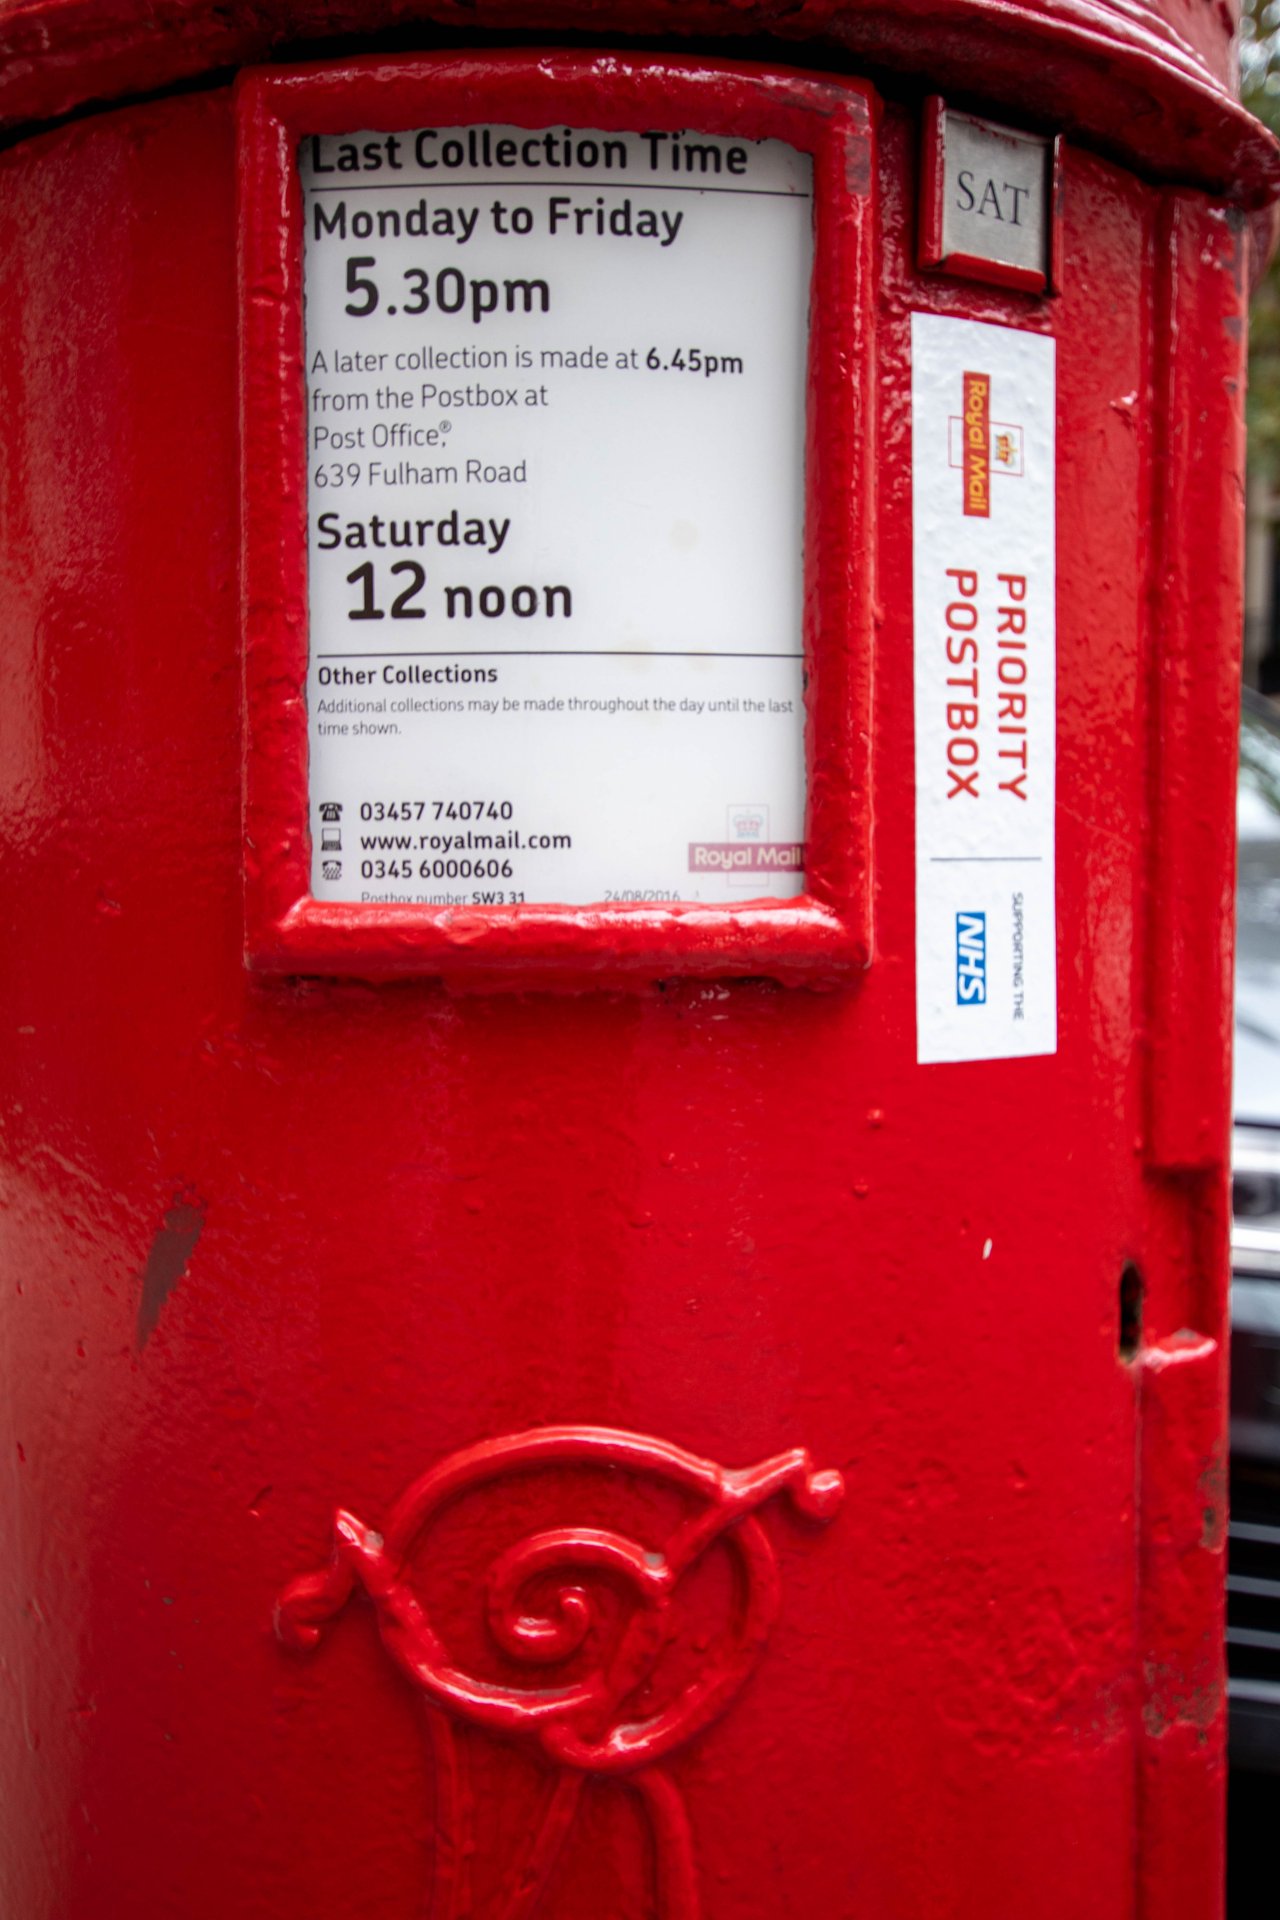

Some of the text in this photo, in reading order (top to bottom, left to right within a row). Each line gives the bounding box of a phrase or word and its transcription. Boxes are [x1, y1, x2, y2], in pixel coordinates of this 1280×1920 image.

[312, 129, 748, 174] Last Collection Time
[956, 170, 1030, 226] SAT
[313, 197, 684, 246] Monday to Friday
[344, 256, 550, 323] 5.30pm
[311, 344, 743, 378] A later collection is made at 6.45pm
[312, 383, 548, 412] from the Postbox at
[313, 425, 365, 451] Post
[965, 379, 988, 511] Royal Mail
[313, 459, 527, 489] 639 Fulham Road
[317, 509, 511, 553] Saturday
[346, 560, 572, 621] 12 noon
[318, 664, 498, 686] Other Collections
[945, 568, 979, 799] POSTBOX
[997, 573, 1027, 800] PRIORITY
[317, 696, 794, 715] Additional collections may be made throughout the day until the last
[318, 720, 402, 736] time shown.
[360, 801, 513, 821] 03457 740740
[360, 830, 571, 853] www.royalmail.com
[694, 847, 801, 868] Royal Mail
[361, 859, 513, 879] 0345 6000606
[361, 891, 526, 905] Postbox number SW3 31
[958, 914, 984, 1002] NHS
[1012, 892, 1024, 1021] SUPPORTING THE
